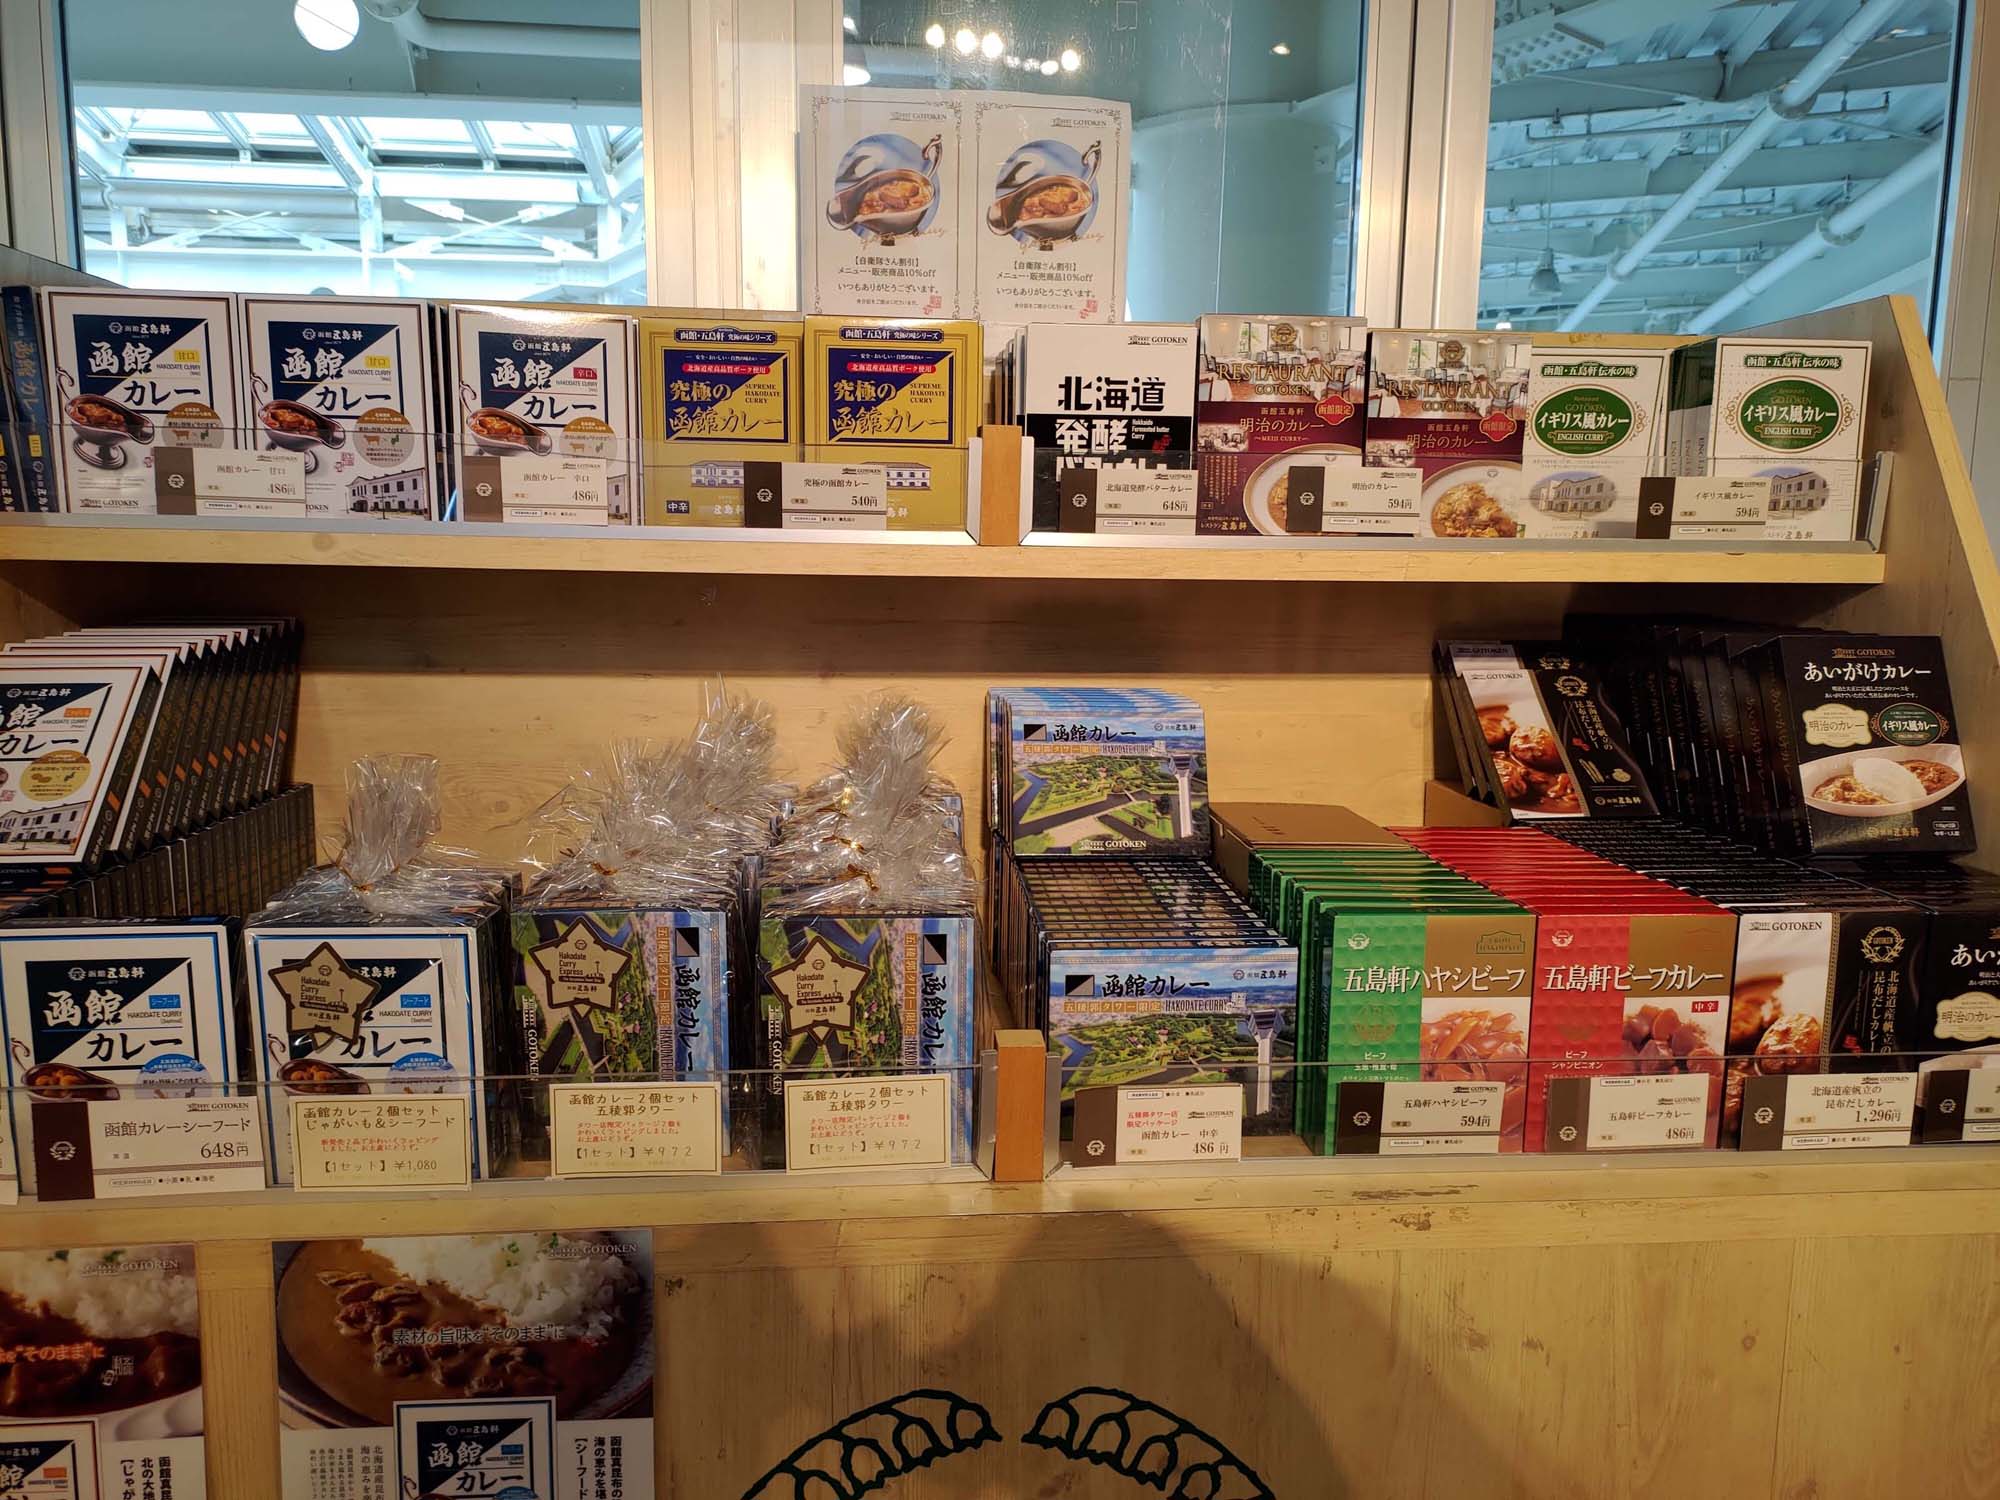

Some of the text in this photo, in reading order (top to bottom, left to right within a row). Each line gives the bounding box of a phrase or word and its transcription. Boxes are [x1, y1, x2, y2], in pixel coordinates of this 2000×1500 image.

[838, 283, 939, 294] いつもありがとうございます。
[997, 288, 1095, 297] いつもありがとうございます。
[1151, 336, 1188, 344] GOTOKEN
[88, 341, 153, 374] 函館
[281, 347, 345, 379] 函館
[491, 357, 554, 389] 函館
[1216, 363, 1349, 382] RESTAURANT
[124, 380, 200, 405] カレー
[669, 379, 732, 402] 究極の
[833, 379, 897, 401] 究極の
[1058, 376, 1166, 412] 北海道
[1255, 384, 1310, 396] GOTOKEN
[1386, 379, 1512, 400] RESTAURANT
[316, 386, 392, 411] カレー
[523, 395, 597, 419] カレー
[1261, 407, 1304, 415] 函館五島軒
[1422, 401, 1476, 412] GOTOKEN
[670, 405, 782, 434] 函館カレー
[832, 406, 947, 434] 函館カレー
[1537, 412, 1630, 429] イギリス風カレー
[1744, 405, 1837, 423] イギリス風カレー
[1240, 417, 1325, 433] 明治のカレー
[1764, 427, 1791, 435] ENGLISH
[1055, 418, 1128, 455] 発酵
[1406, 434, 1488, 449] 明治のカレー
[804, 479, 870, 488] 究極の函館カレー
[1352, 481, 1398, 490] 明治のカレー
[668, 501, 689, 512] 中辛
[851, 496, 877, 506] 540円
[1804, 662, 1932, 682] あいがけカレー
[0, 703, 45, 728] 館
[1809, 719, 1865, 732] 明治のカレー
[1882, 719, 1938, 733] イギリス風カレー
[1052, 723, 1137, 742] 函館カレー
[0, 734, 79, 755] カレー
[1105, 840, 1146, 848] GOTOKEN
[1771, 921, 1823, 931] GOTOKEN
[559, 951, 587, 960] Hakodate
[559, 960, 576, 969] Curry
[560, 967, 583, 975] Express
[301, 976, 330, 986] Hakodate
[1342, 965, 1526, 994] 五島軒ハヤシビーフ
[1542, 963, 1725, 992] 五島軒ビーフカレー
[301, 984, 319, 995] Curry
[797, 982, 814, 991] Curry
[1102, 974, 1211, 997] 函館カレー
[301, 992, 326, 1002] Express
[797, 990, 821, 999] Express
[43, 989, 124, 1027] 函館
[1064, 1000, 1161, 1013] 五稜郭タワー限定
[1165, 1000, 1201, 1012] HAKODATE
[1695, 1002, 1716, 1012] 中辛
[1869, 970, 1886, 1053] 昆布だしカレー
[1881, 970, 1900, 1054] 北海道産帆立の
[127, 1010, 183, 1019] HAKODATE CURRY
[675, 964, 701, 1071] 函館カレー
[87, 1032, 183, 1061] カレー
[340, 1030, 432, 1059] カレー
[527, 1028, 539, 1081] GOTOKEN
[1364, 1051, 1387, 1060] ビーフ
[1565, 1050, 1588, 1059] ビーフ
[802, 1086, 928, 1101] 函館カレー2個セット
[1811, 1085, 1882, 1097] 北海道産帆立の
[569, 1092, 699, 1104] 函館カレー2個セット
[1403, 1098, 1488, 1109] 五島軒ハヤシビーフ
[1825, 1098, 1896, 1110] 昆布だしカレー
[304, 1105, 440, 1118] 函館カレー2個セット
[597, 1105, 674, 1116] 五稜郭タワー
[827, 1099, 904, 1111] 五稜郭タワー
[1460, 1115, 1491, 1127] 594円
[1608, 1109, 1693, 1121] 五島軒ビーフカレー
[104, 1117, 251, 1138] 函館カレーシーフード
[306, 1117, 455, 1130] じゃがいも&シーフード
[1142, 1129, 1219, 1140] 函館カレー 中辛
[1666, 1127, 1694, 1139] 486円
[200, 1141, 249, 1159] 648円
[583, 1243, 638, 1254] GOTOKEN
[120, 1259, 179, 1273] GOTOKEN
[428, 1441, 483, 1468] 函館
[456, 1471, 524, 1494] カレー
